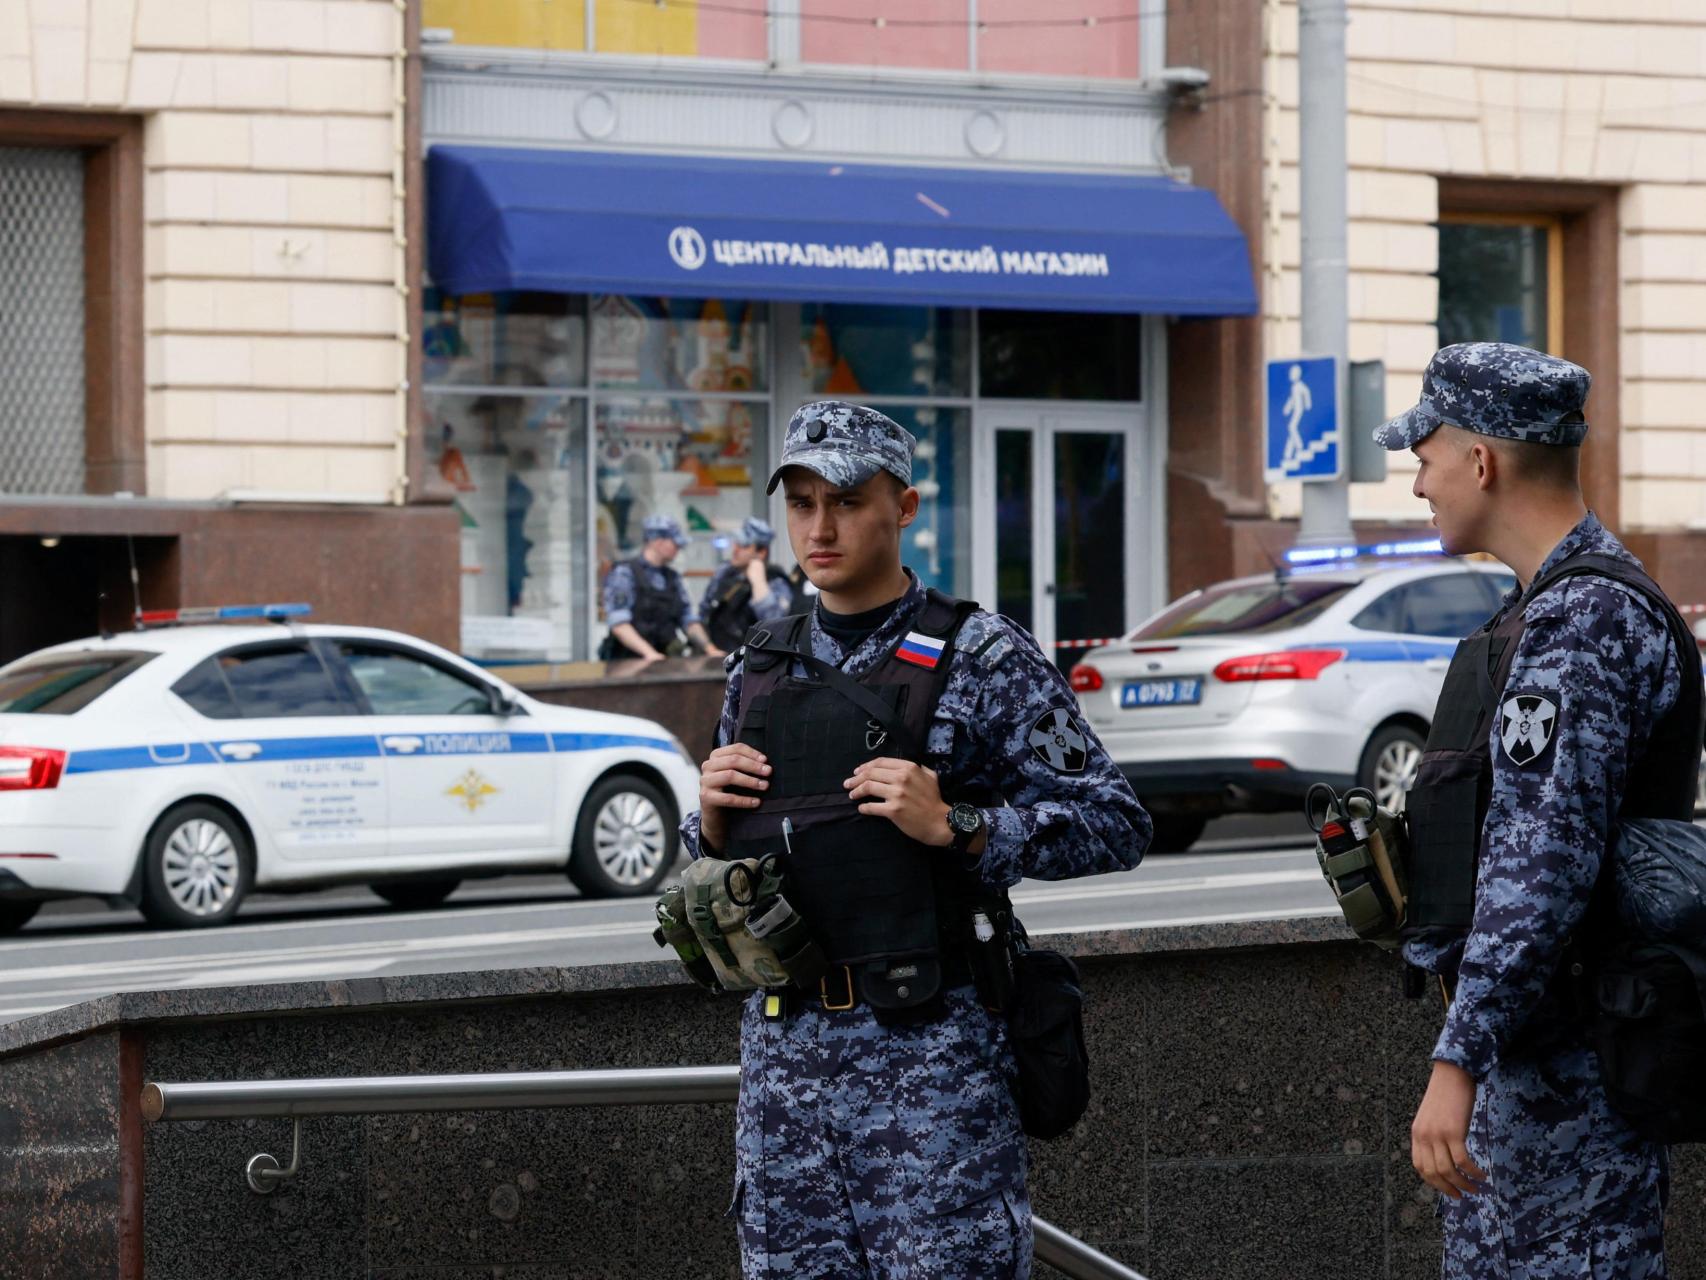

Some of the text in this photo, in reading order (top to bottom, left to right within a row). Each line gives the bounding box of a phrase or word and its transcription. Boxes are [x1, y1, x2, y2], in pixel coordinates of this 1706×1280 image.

[712, 239, 1109, 276] ЦЕНТРАЛЬНЫЙ ДЕТСКИЙ МАГАЗИН
[424, 734, 512, 753] ПОЛИЦИЯ
